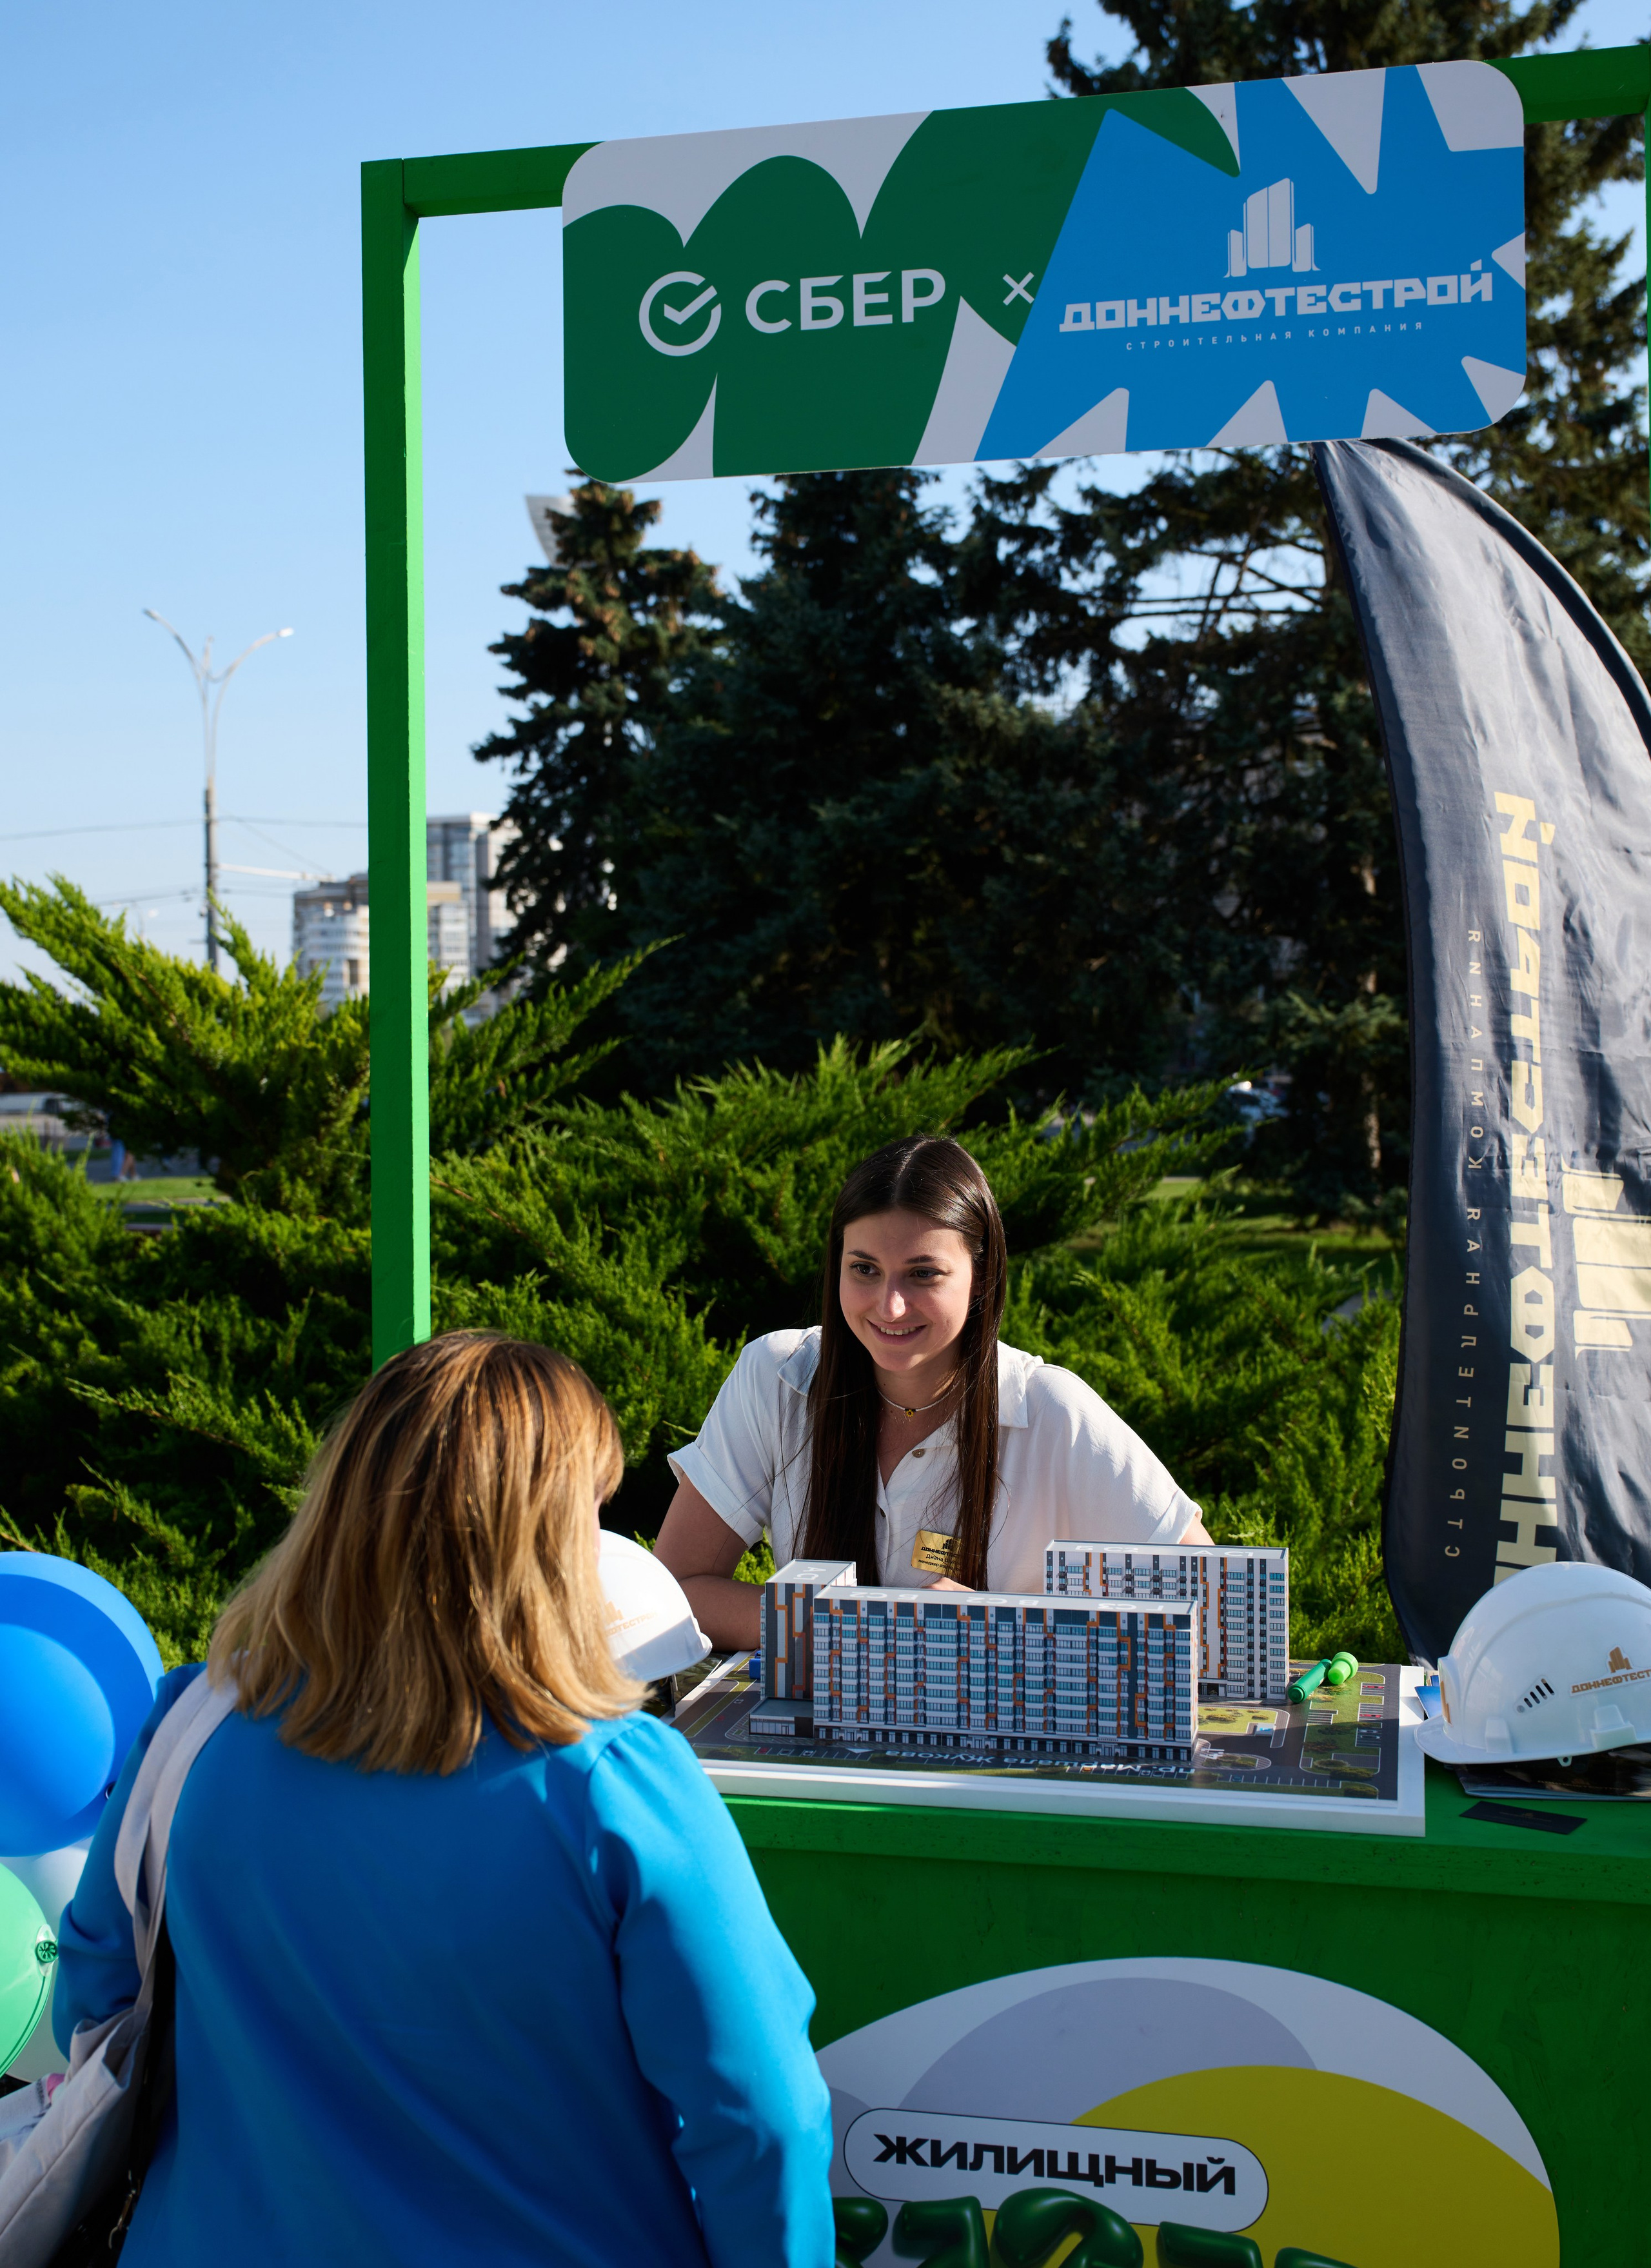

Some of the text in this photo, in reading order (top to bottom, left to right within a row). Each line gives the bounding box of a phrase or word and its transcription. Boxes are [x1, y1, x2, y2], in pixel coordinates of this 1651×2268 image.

[746, 268, 946, 333] СБЕР
[1059, 259, 1493, 332] ДОННЕФТЕСТРОЙ
[1126, 322, 1423, 351] СТРОИТЕЛЬНАЯ КОМПАНИЯ
[918, 1559, 940, 1567] менеджер
[885, 1750, 996, 1764] Жукова
[1003, 1757, 1142, 1773] Маршала
[873, 2133, 1236, 2196] ЖИЛИЩНЫЙ
